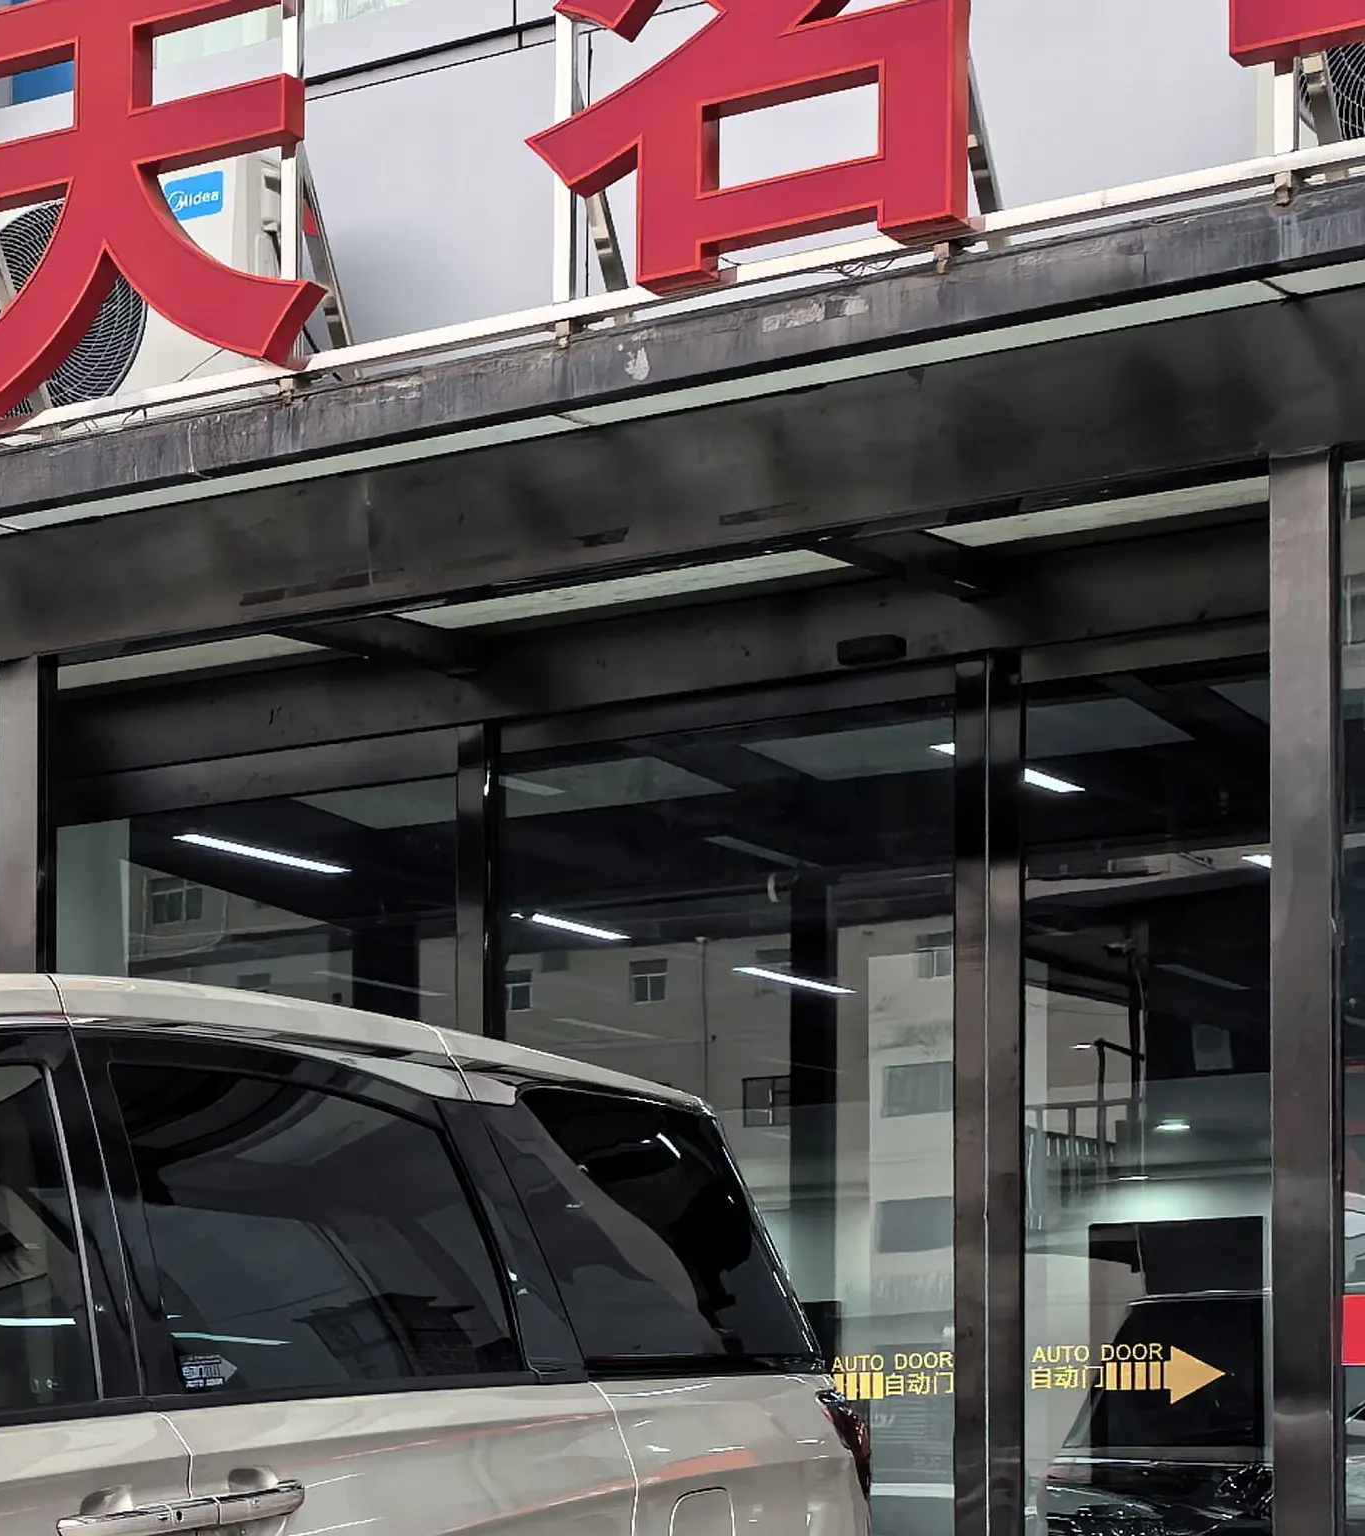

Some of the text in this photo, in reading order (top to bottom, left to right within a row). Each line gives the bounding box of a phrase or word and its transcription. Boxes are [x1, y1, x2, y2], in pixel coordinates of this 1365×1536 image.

[167, 190, 219, 213] Midea
[832, 1351, 954, 1373] AUTO DOOR
[1032, 1342, 1164, 1363] AUTO DOOR
[885, 1371, 954, 1396] 自动门
[1030, 1365, 1105, 1390] 自动门
